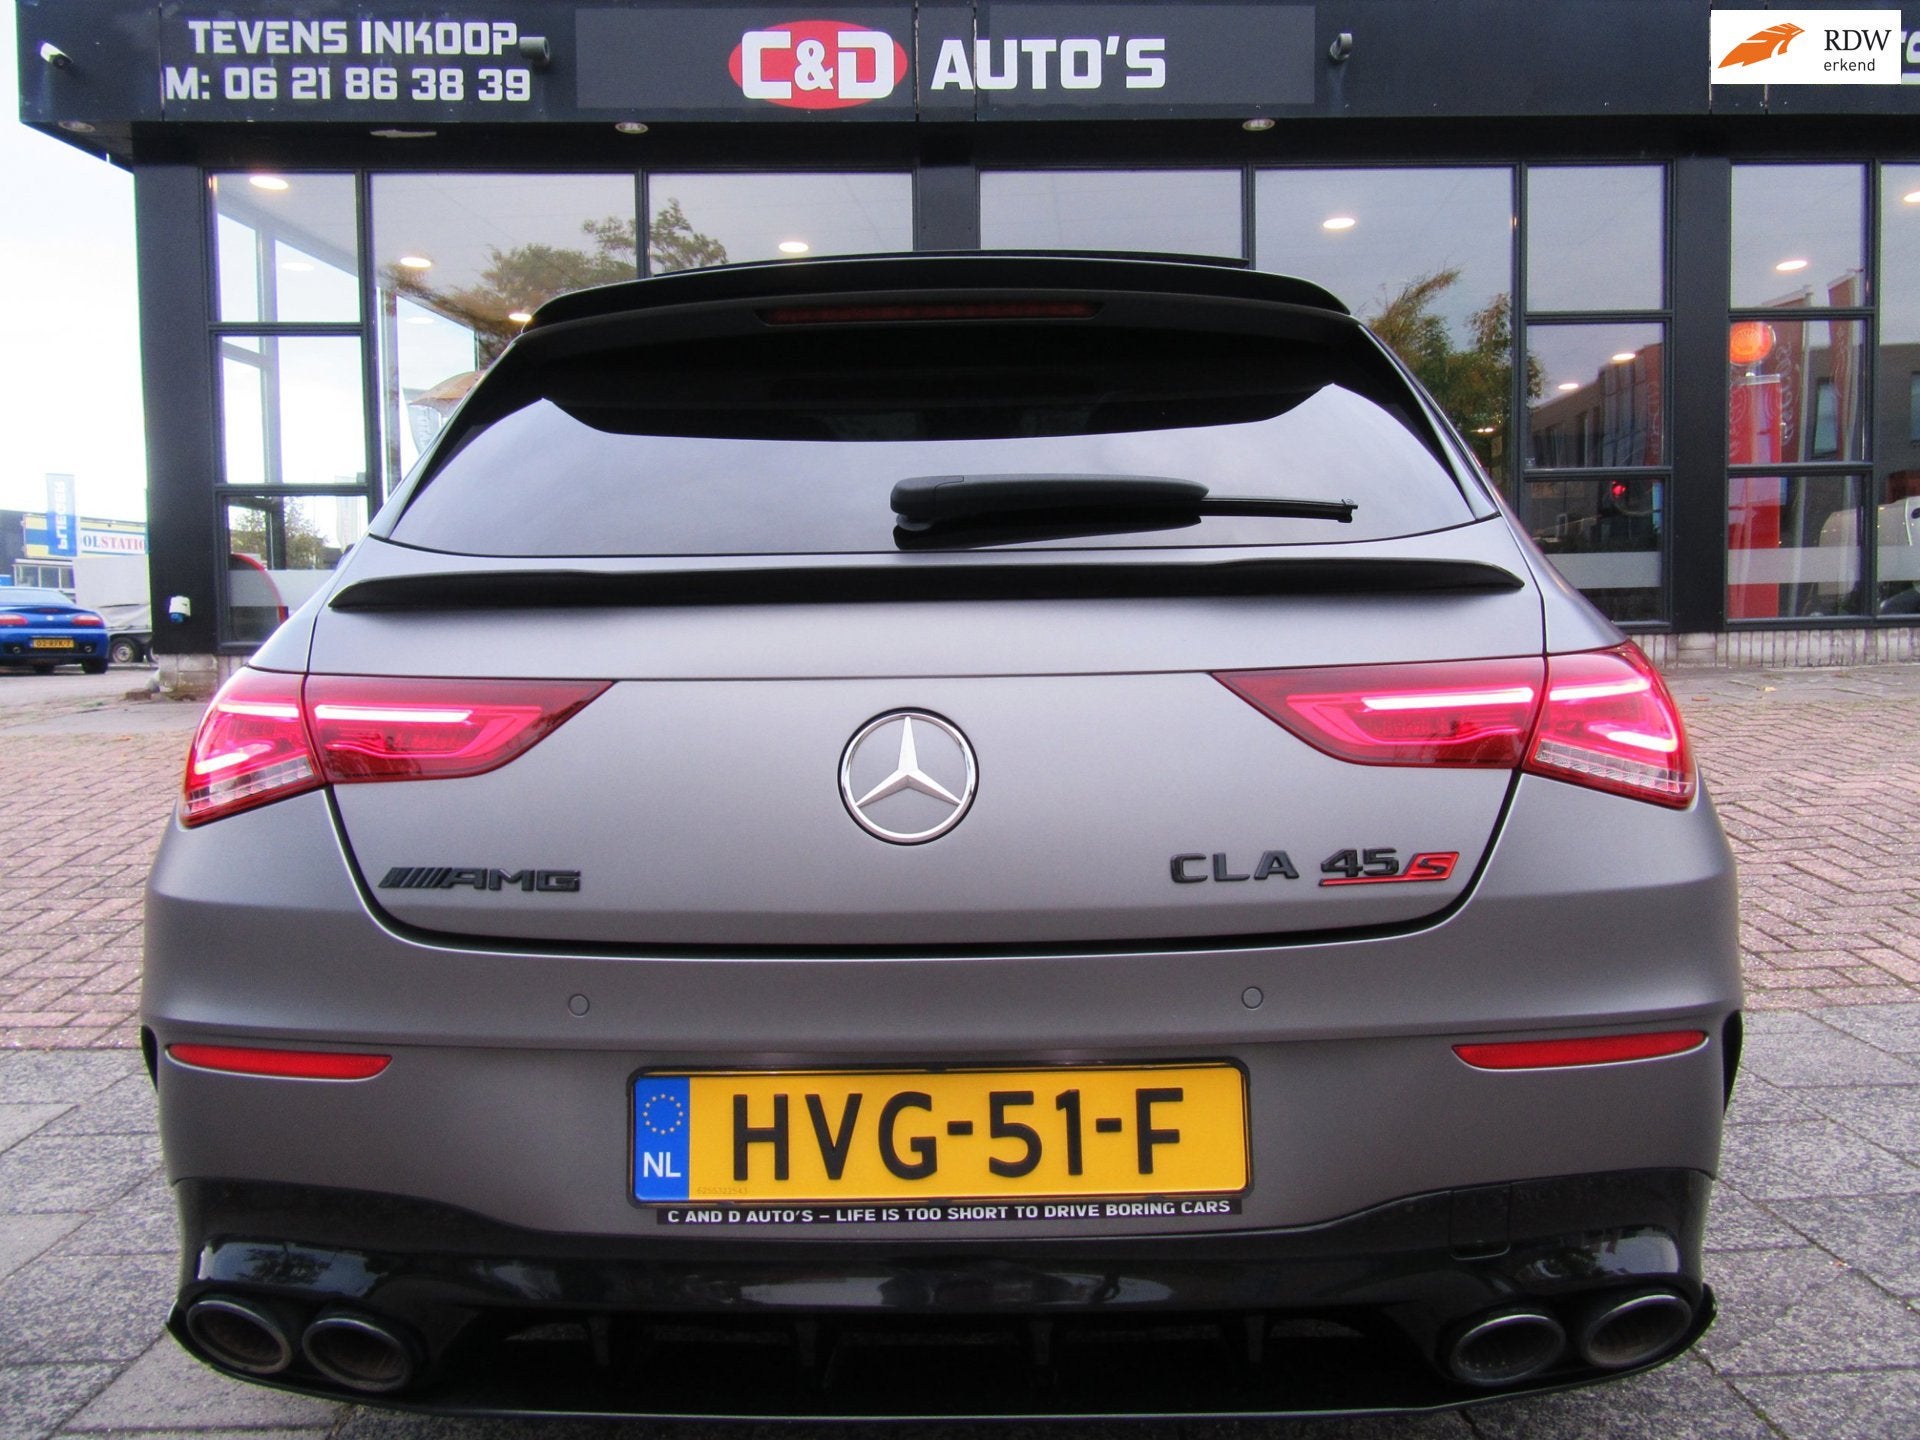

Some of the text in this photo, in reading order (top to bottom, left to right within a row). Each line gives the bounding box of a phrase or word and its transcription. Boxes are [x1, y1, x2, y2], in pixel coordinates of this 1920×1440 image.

[188, 20, 518, 56] TEVENS INKOOP
[741, 31, 1166, 100] C&D AUTO'S
[164, 67, 531, 102] M: 06 21 86 38 39
[1169, 850, 1300, 883] CLA
[732, 1088, 1184, 1181] HVG-51-F
[642, 1151, 682, 1179] NL
[667, 1210, 680, 1223] C
[685, 1210, 723, 1223] AND
[727, 1210, 741, 1223] D
[746, 1210, 814, 1223] AUTO'S
[835, 1208, 877, 1222] LIFE
[881, 1208, 900, 1221] IS
[905, 1207, 942, 1221] TOO
[946, 1206, 1009, 1220] SHORT
[1013, 1205, 1039, 1219] TO
[1043, 1204, 1101, 1218] DRIVE
[1105, 1202, 1176, 1217] BORING
[1180, 1200, 1232, 1214] CARS
